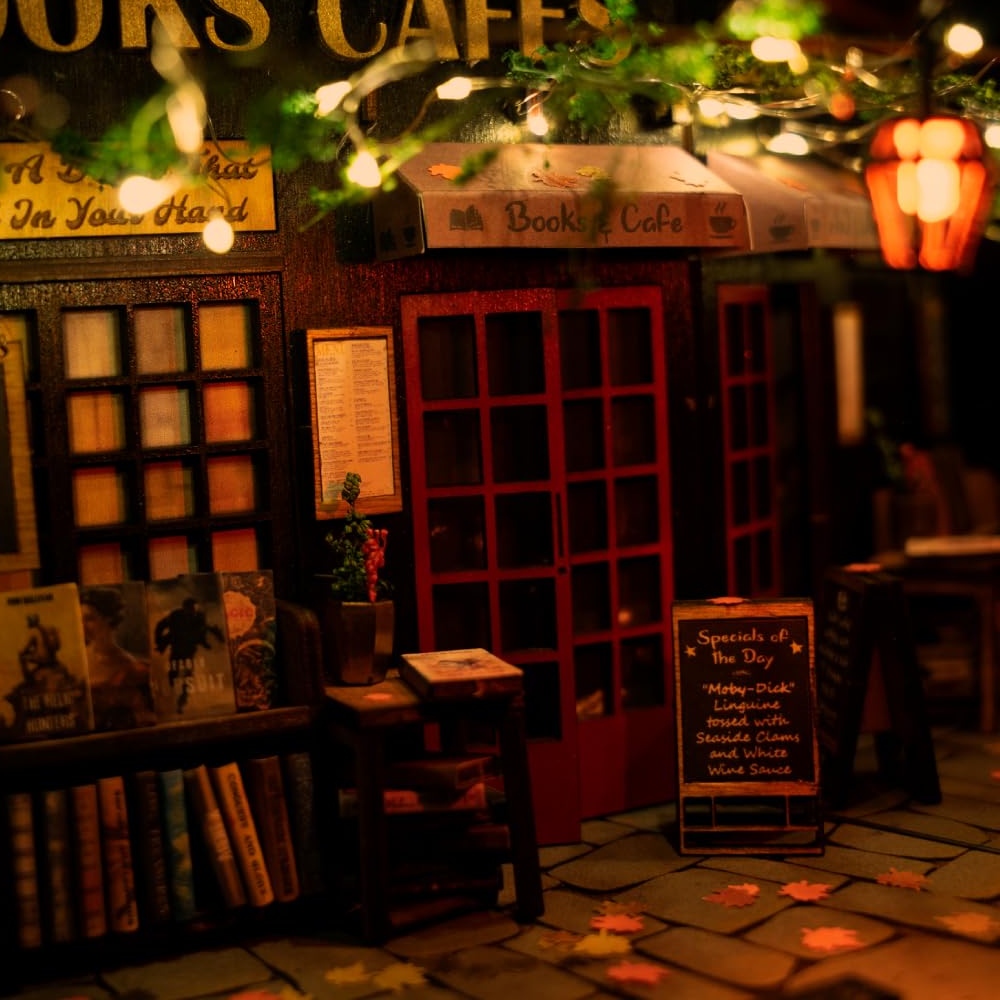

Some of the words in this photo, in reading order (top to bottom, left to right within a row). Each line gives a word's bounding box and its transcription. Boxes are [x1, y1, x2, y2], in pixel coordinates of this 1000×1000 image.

[4, 154, 45, 185] A
[10, 198, 56, 230] In
[505, 201, 587, 233] Books
[621, 201, 683, 234] Cafe
[696, 627, 765, 649] Specials
[770, 628, 790, 642] of
[741, 648, 775, 671] Day
[714, 699, 782, 713] Linguine
[706, 715, 750, 728] tossed
[754, 714, 791, 727] with
[696, 731, 751, 744] Seaside
[755, 731, 800, 744] Clams
[709, 746, 740, 759] and
[743, 745, 789, 759] White
[707, 764, 745, 776] Wine
[749, 763, 793, 776] Sauce
